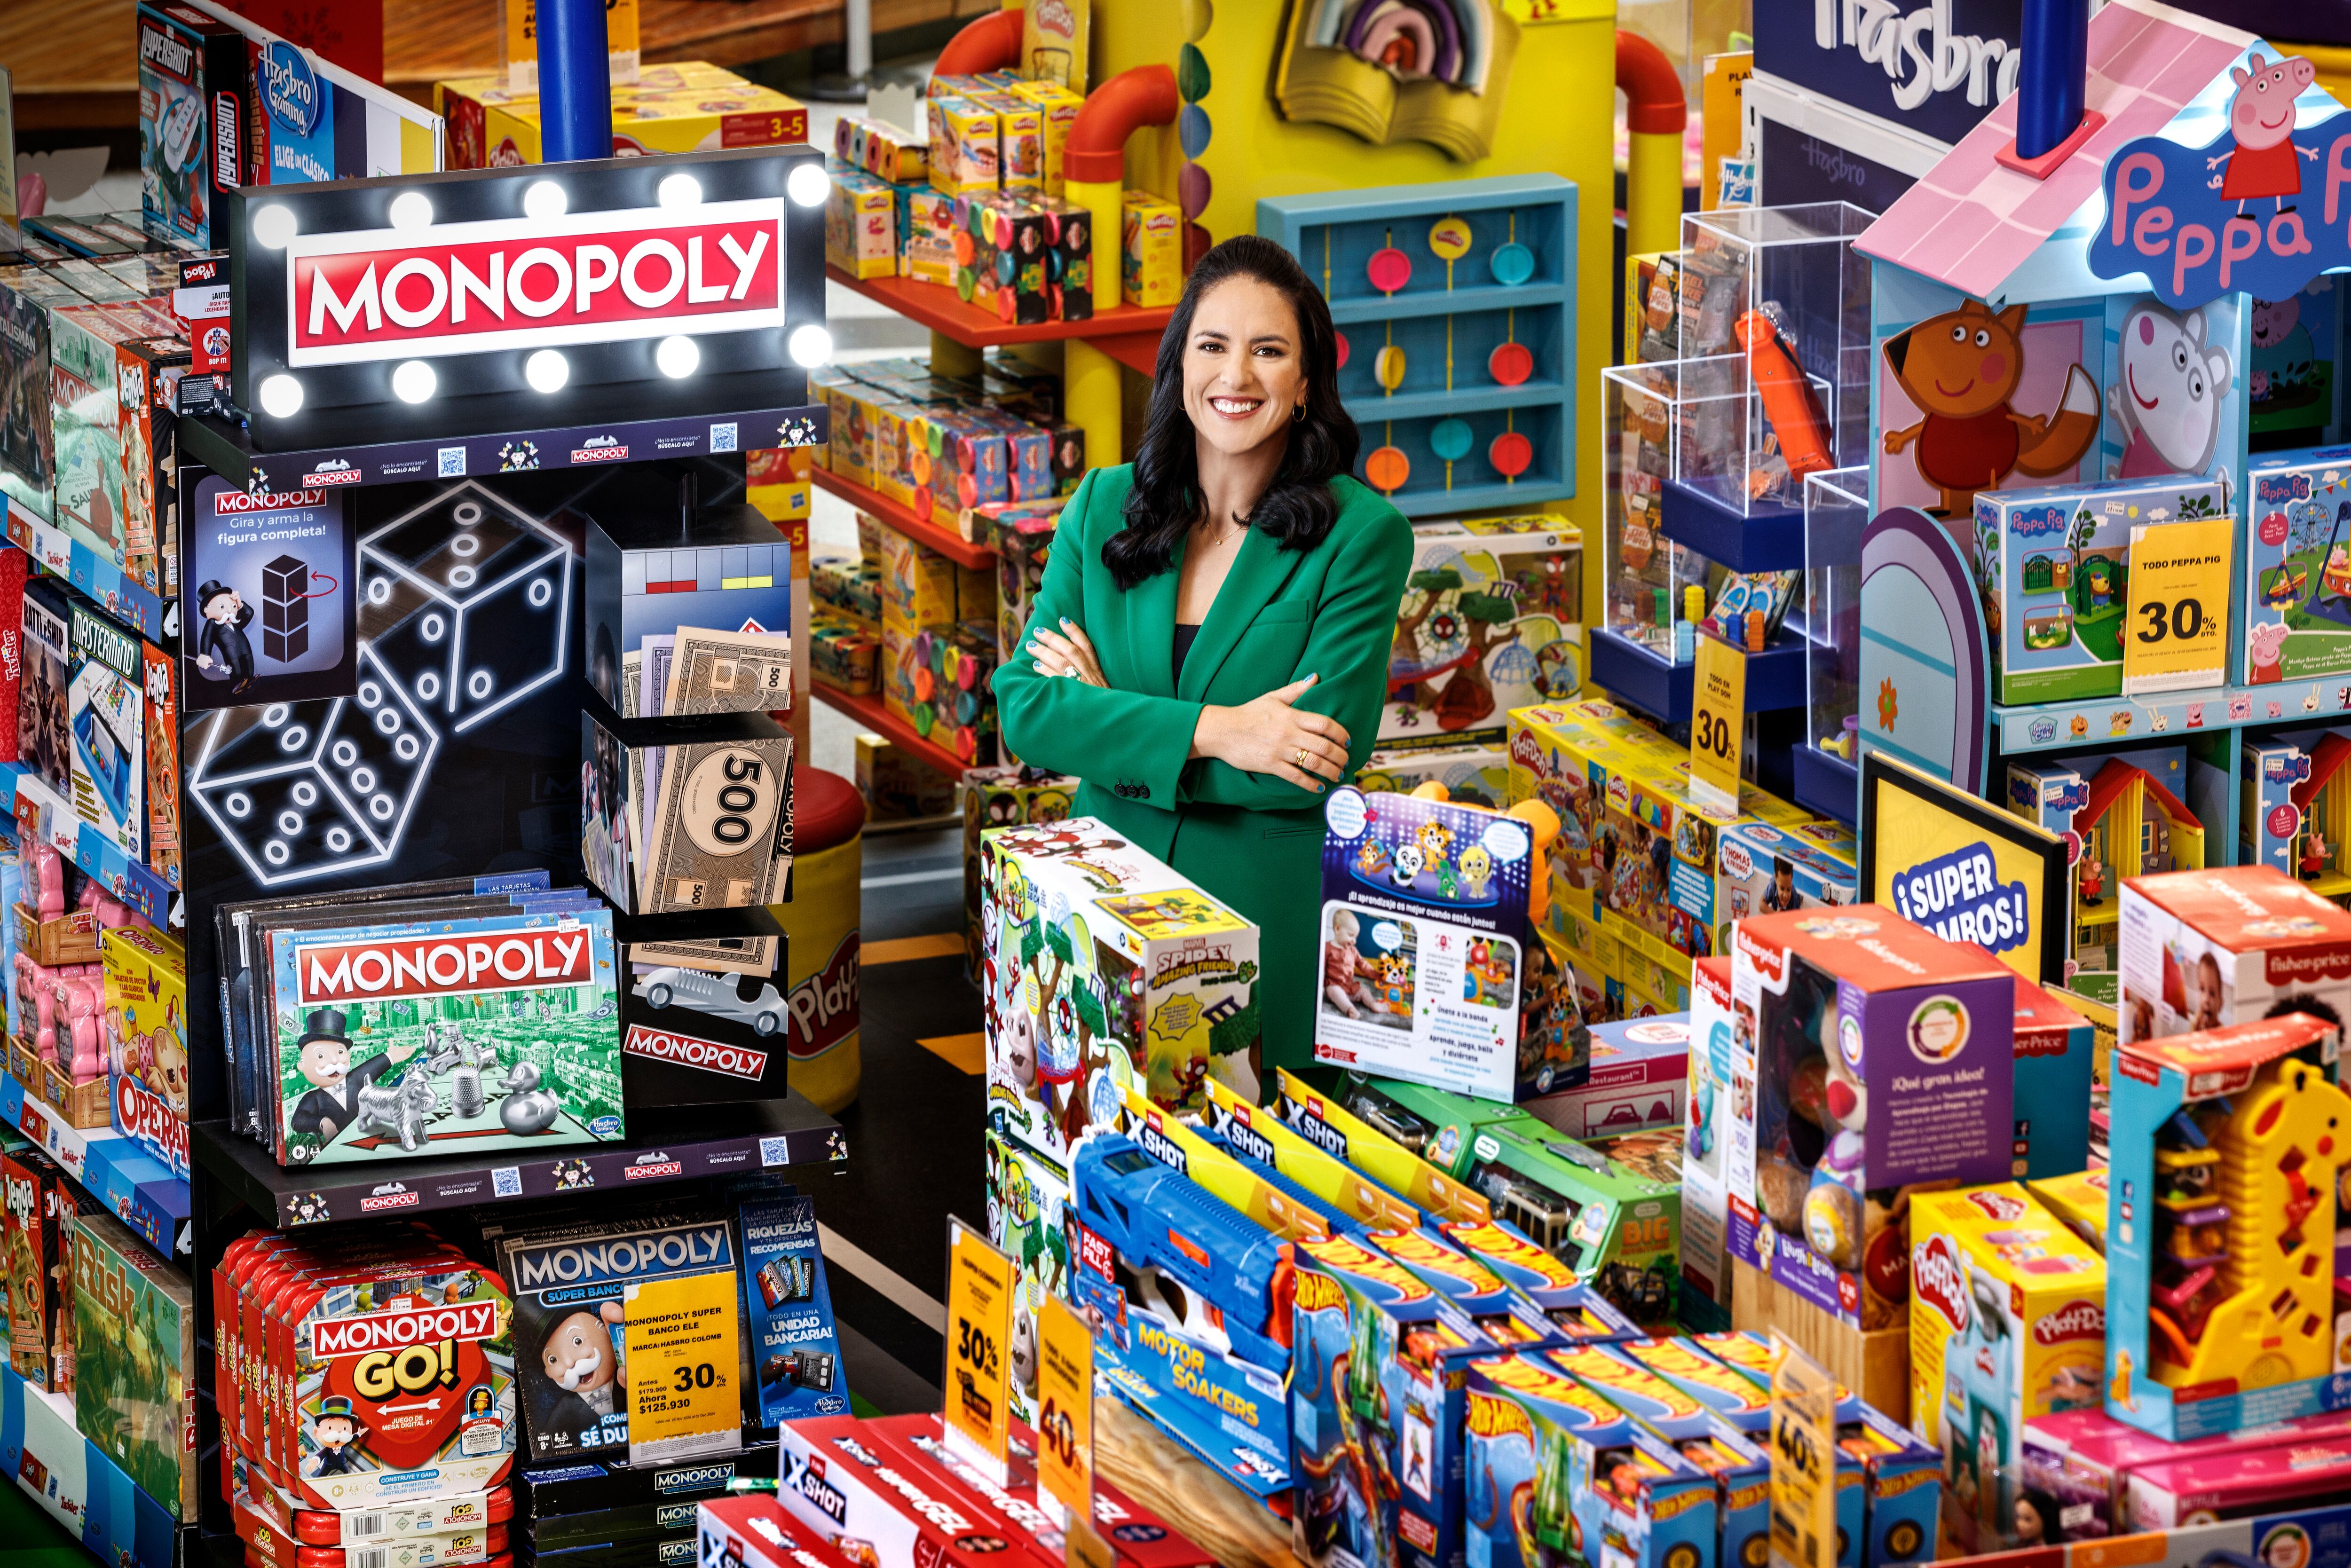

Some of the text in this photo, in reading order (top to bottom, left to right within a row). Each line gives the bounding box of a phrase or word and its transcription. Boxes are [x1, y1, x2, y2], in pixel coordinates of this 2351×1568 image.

[141, 25, 192, 76] HYPERSHOT
[258, 37, 311, 104] Hasbro
[268, 82, 308, 136] Gaming
[217, 91, 240, 188] HYPERSHOT
[771, 118, 804, 138] 3-5
[275, 145, 294, 170] ELIGE
[295, 154, 301, 169] UN
[1801, 136, 1865, 186] Hasbro
[2112, 152, 2312, 296] Peppa
[184, 265, 205, 280] bop
[307, 230, 770, 334] MONOPOLY
[119, 364, 144, 411] Jenga
[55, 374, 118, 435] MONOPOLY
[396, 460, 426, 468] encontraste?
[573, 448, 626, 461] MONOPOLY
[305, 471, 359, 486] MONOPOLY
[2260, 477, 2308, 502] Peppa Pig
[219, 489, 322, 512] MONOPOLY
[230, 512, 313, 528] Gira y arma la
[2013, 509, 2066, 534] Peppa Pig
[217, 524, 326, 547] figura completa!
[47, 550, 64, 568] Twister
[2142, 555, 2220, 570] TODO PEPPA PIG
[24, 600, 63, 654] BATTLESHIP
[2137, 599, 2217, 644] 30 %
[73, 611, 134, 676] MASTERMIND
[4, 631, 20, 682] Twister
[145, 659, 169, 706] Jenga
[769, 667, 780, 688] 500
[1709, 673, 1723, 686] TODO
[1707, 683, 1731, 700] PLAY DOH
[1696, 709, 1728, 758] 30
[1511, 735, 1546, 775] Play-Doh
[712, 753, 763, 845] 500
[1724, 845, 1750, 868] THOMAS
[1730, 859, 1748, 875] FRIENDS
[501, 882, 531, 891] TARJETAS
[691, 883, 703, 905] 500
[1897, 853, 1994, 921] ¡SUPER
[1348, 890, 1496, 930] ¡El aprendizaje es mejor cuando están juntos!
[390, 927, 425, 937] propiedades
[309, 936, 584, 995] MONOPOLY
[1157, 944, 1231, 973] SPIDEY
[114, 974, 128, 983] TARJETAS
[1153, 960, 1236, 989] AMAZING FRIENDS
[120, 993, 146, 1002] ENFERMEDADES!
[222, 977, 234, 1062] MONOPOLY
[629, 1028, 762, 1075] MONOPOLY
[1892, 1068, 1985, 1092] ¡Qué gran idea!
[62, 1147, 79, 1166] Twister
[155, 1150, 169, 1165] MEJORAR
[627, 1164, 680, 1177] MONOPOLY
[6, 1174, 35, 1219] Jenga
[363, 1195, 417, 1210] MONOPOLY
[747, 1221, 813, 1240] RIQUEZAS
[1623, 1217, 1670, 1245] BIG
[750, 1238, 815, 1254] RECOMPENSAS
[1082, 1231, 1111, 1254] FAST
[523, 1230, 721, 1285] MONOPOLY
[1082, 1244, 1102, 1269] FILL
[75, 1228, 135, 1334] Risk
[767, 1266, 783, 1293] MONOPOLY
[1915, 1245, 1966, 1329] Play-Doh
[547, 1286, 588, 1302] SÚPER
[625, 1307, 722, 1327] MONONOPOLY SUPER
[766, 1313, 789, 1322] ¡TODO
[772, 1315, 820, 1333] UNIDAD
[320, 1306, 491, 1352] MONOPOLY
[648, 1322, 700, 1336] BANCO ELE
[765, 1327, 833, 1346] BANCARIA!
[632, 1333, 722, 1352] MARCA: HASBRO COLOMB
[958, 1318, 986, 1369] 30
[1138, 1323, 1206, 1374] MOTOR
[354, 1339, 457, 1398] GO!
[673, 1363, 726, 1393] 30 %
[638, 1387, 667, 1395] $179.900
[639, 1395, 666, 1404] Ahora
[1171, 1365, 1260, 1427] SOAKERS
[639, 1398, 690, 1415] $125.930
[818, 1398, 842, 1408] Hasbro
[400, 1420, 425, 1429] DIGITAL
[540, 1442, 549, 1450] 8+
[580, 1425, 601, 1448] SÉ
[380, 1475, 415, 1484] CONSTRUYE
[658, 1466, 732, 1487] MONOPOLY
[444, 1513, 481, 1524] MONOPOLY
[451, 1503, 474, 1517] GO!
